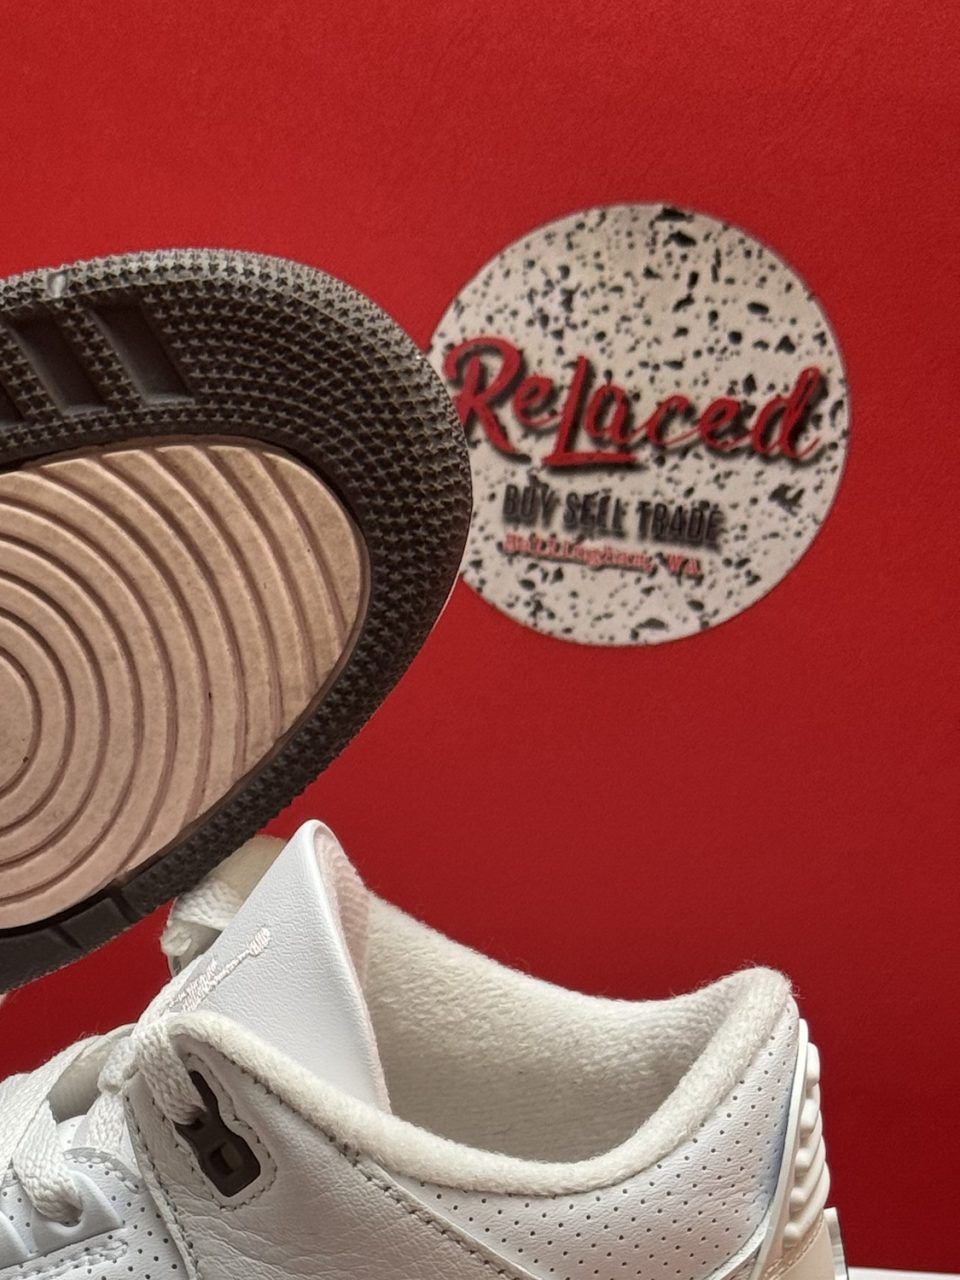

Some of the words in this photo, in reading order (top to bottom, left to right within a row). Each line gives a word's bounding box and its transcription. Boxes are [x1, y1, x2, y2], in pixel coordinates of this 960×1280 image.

[442, 336, 821, 467] ReLaced
[503, 484, 558, 527] BUY
[563, 491, 626, 538] SELL
[638, 500, 724, 551] TRADE
